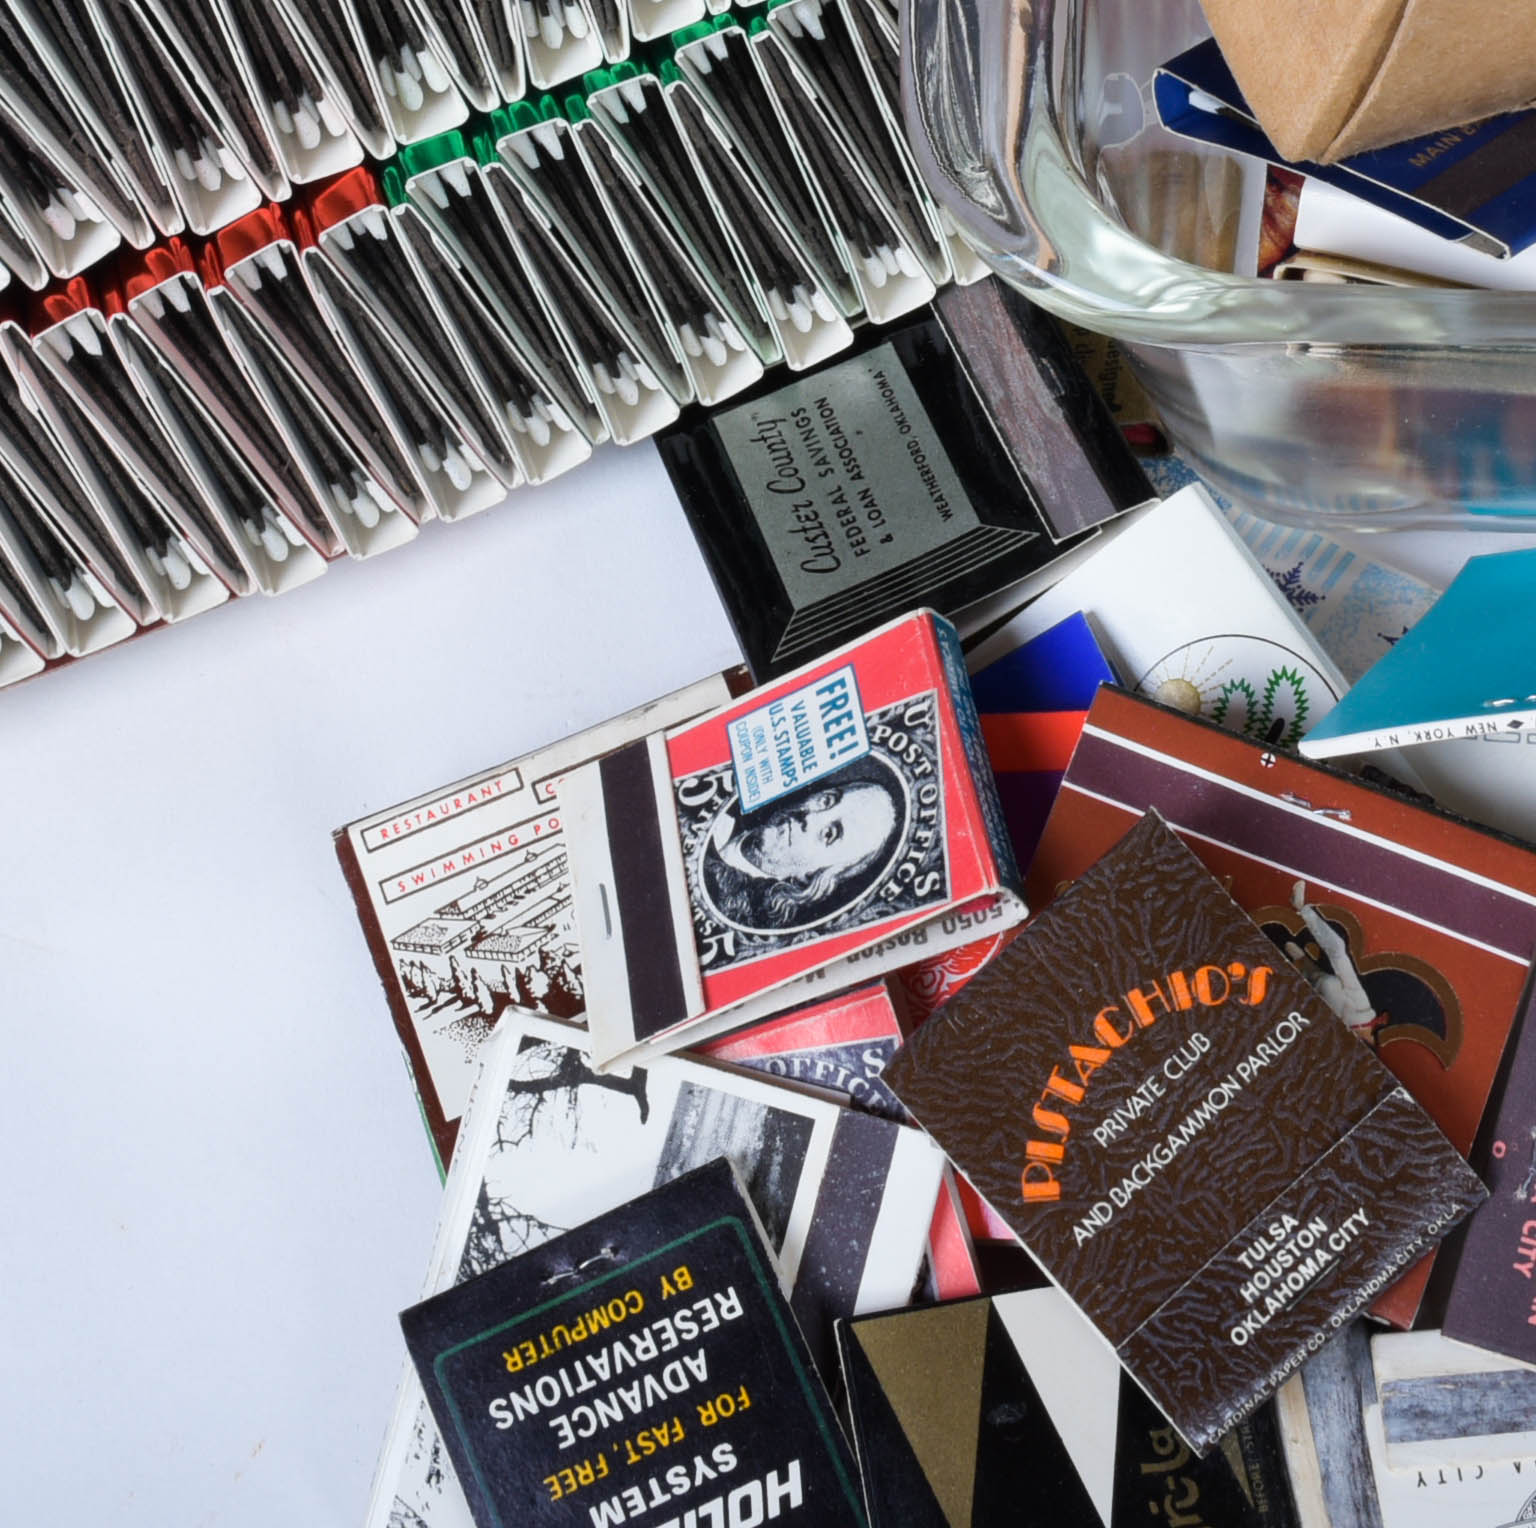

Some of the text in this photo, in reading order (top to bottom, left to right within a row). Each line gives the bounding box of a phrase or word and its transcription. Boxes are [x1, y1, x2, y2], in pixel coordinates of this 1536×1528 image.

[749, 418, 842, 574] Custer County
[790, 407, 871, 557] FEDERAL SAVINGS
[814, 392, 886, 529] LOAN ASSOCIATION
[871, 367, 955, 524] WEATHERFORD, OKLAHOMA
[760, 759, 773, 783] WITH
[773, 730, 798, 788] STAMPS
[790, 700, 818, 774] VALUABLE
[815, 677, 859, 760] FREE!
[1466, 723, 1497, 734] NEW
[379, 780, 501, 839] RESTAURANT
[397, 834, 519, 893] SWIMMING
[871, 725, 938, 902] POST OFFICE
[1021, 963, 1274, 1202] PISTACHIO'S
[1073, 1011, 1310, 1247] AND BACKGAMMON PARLOR
[1092, 1032, 1211, 1148] PRIVATE CLUB
[1224, 1207, 1369, 1346] OKLAHOMA CITY
[1235, 1212, 1328, 1303] HOUSTON
[1237, 1214, 1299, 1274] TULSA
[488, 1286, 744, 1430] RESERVATIONS
[502, 1266, 693, 1373] BY COMPUTER
[1202, 1265, 1403, 1449] CARDINAL PAPER OKLAHOMA
[543, 1386, 750, 1501] FOR FAST, FREE
[548, 1348, 708, 1449] ADVANCE
[588, 1442, 739, 1528] SYSTEM
